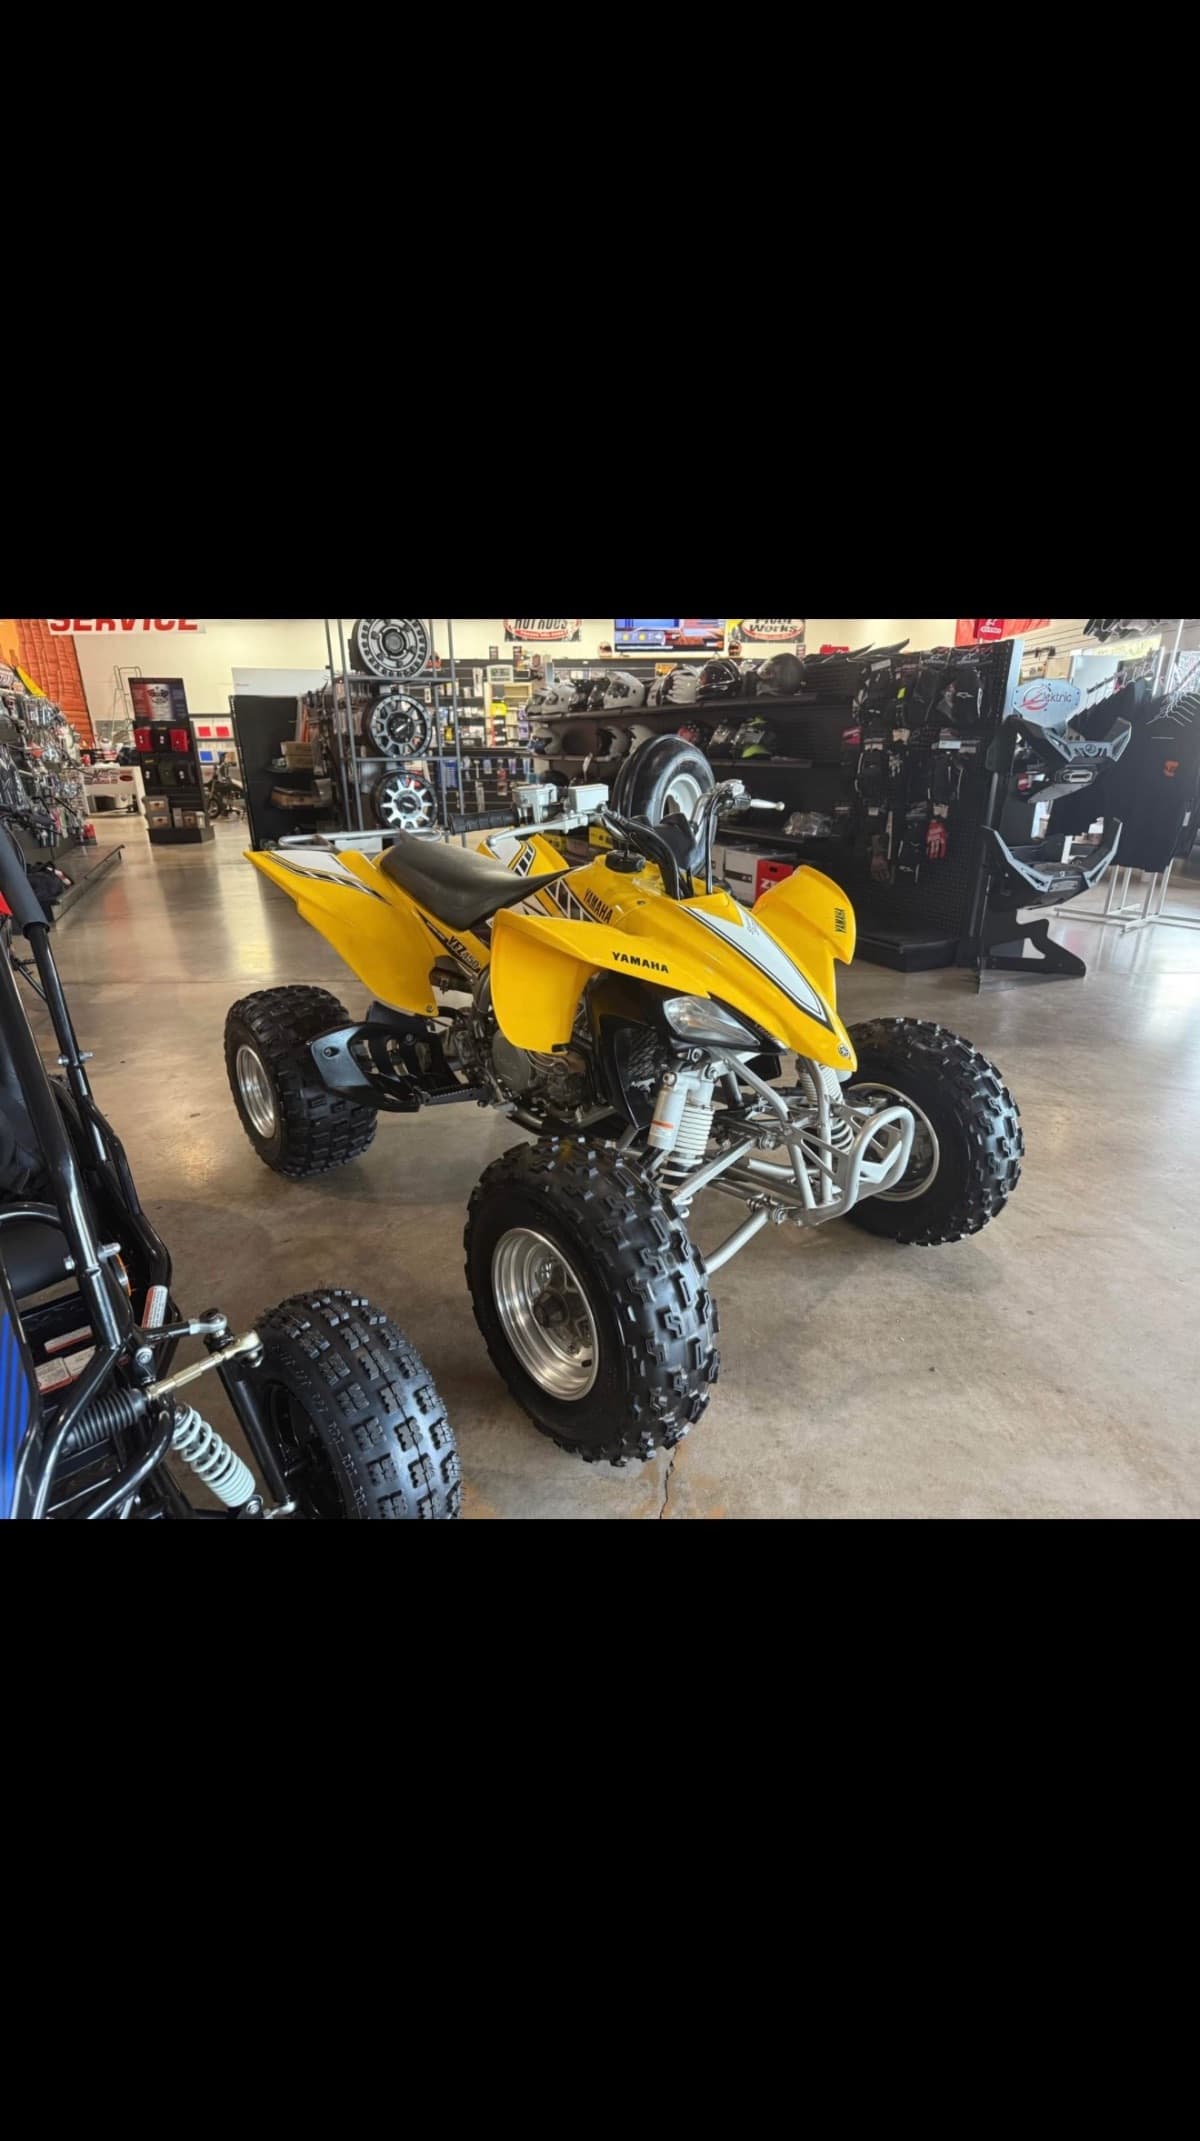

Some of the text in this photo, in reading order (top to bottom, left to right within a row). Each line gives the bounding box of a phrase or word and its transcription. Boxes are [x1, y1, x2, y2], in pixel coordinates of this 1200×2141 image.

[50, 619, 198, 631] SERVICE
[749, 624, 798, 633] Works
[583, 888, 613, 924] YAMAHA
[612, 952, 669, 974] YAMAHA
